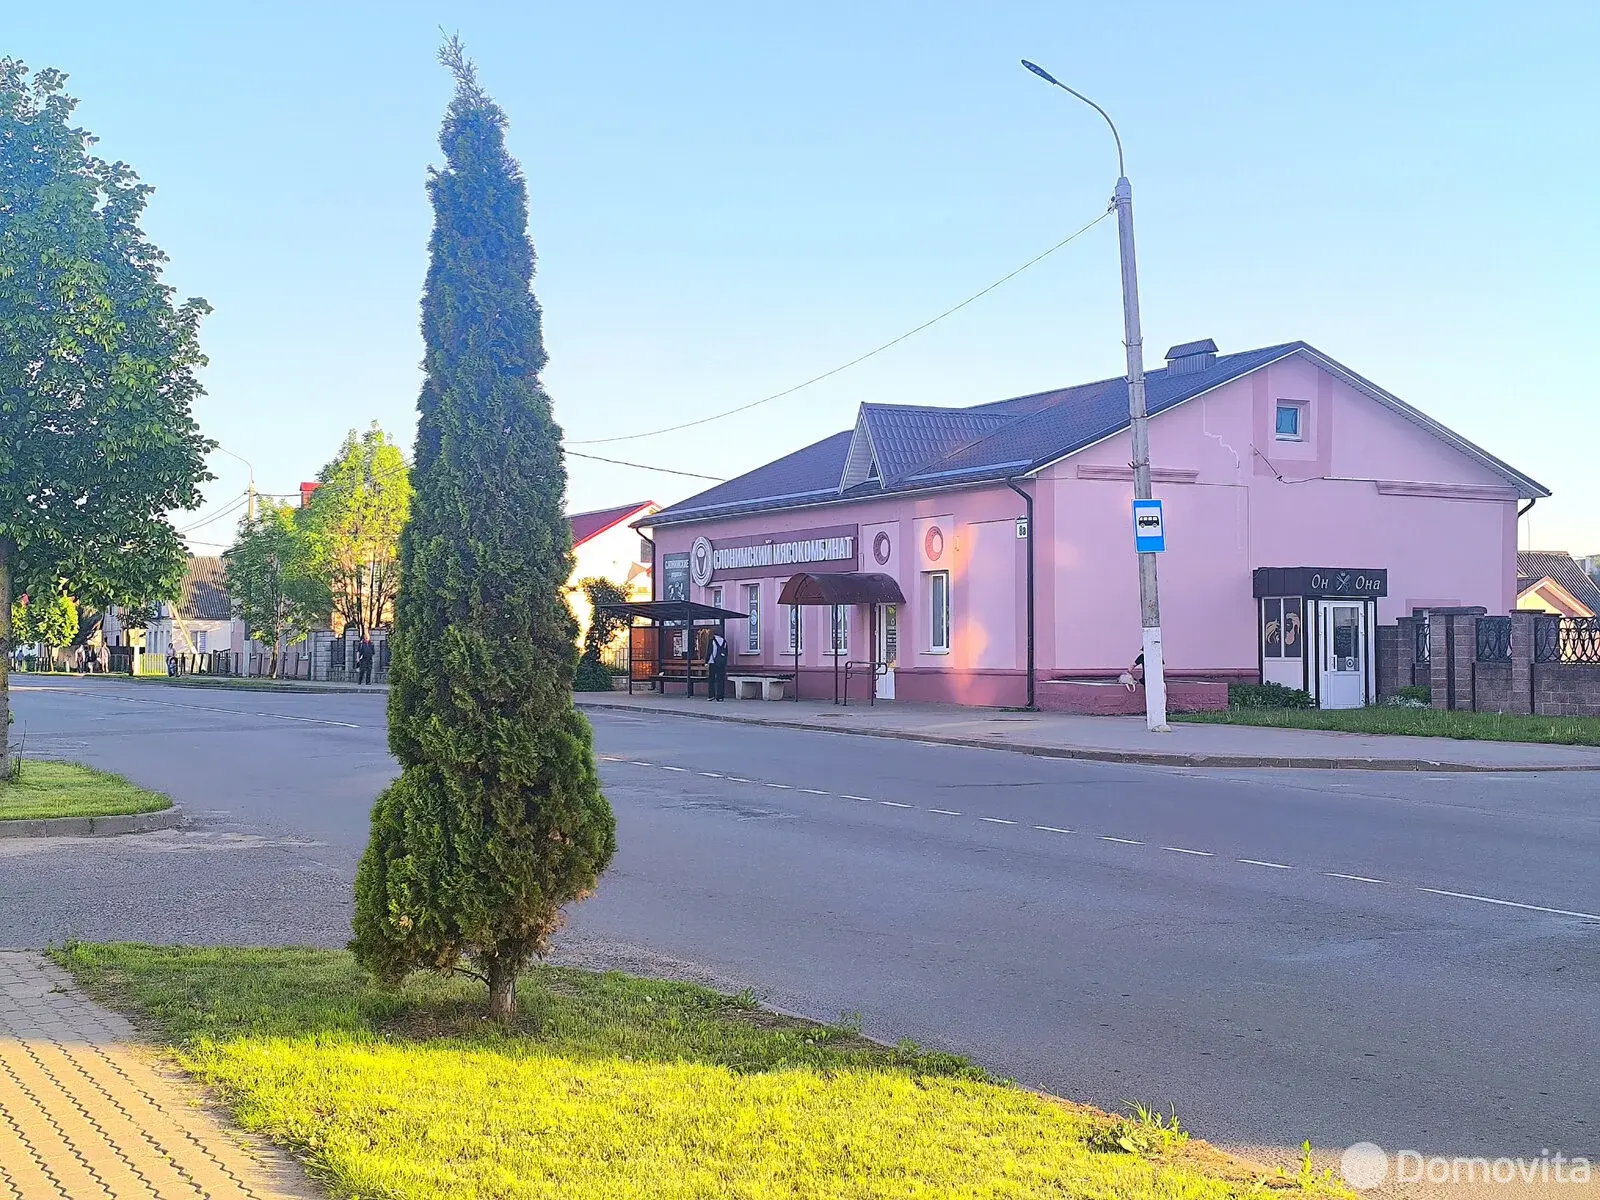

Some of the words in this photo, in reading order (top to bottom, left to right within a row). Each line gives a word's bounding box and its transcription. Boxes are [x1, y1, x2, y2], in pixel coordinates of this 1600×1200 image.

[713, 540, 773, 570] СЛОНИМСКИЙ
[773, 536, 854, 565] МЯСОКОМБИНАТ
[1311, 574, 1329, 589] Он
[1355, 575, 1381, 590] Она
